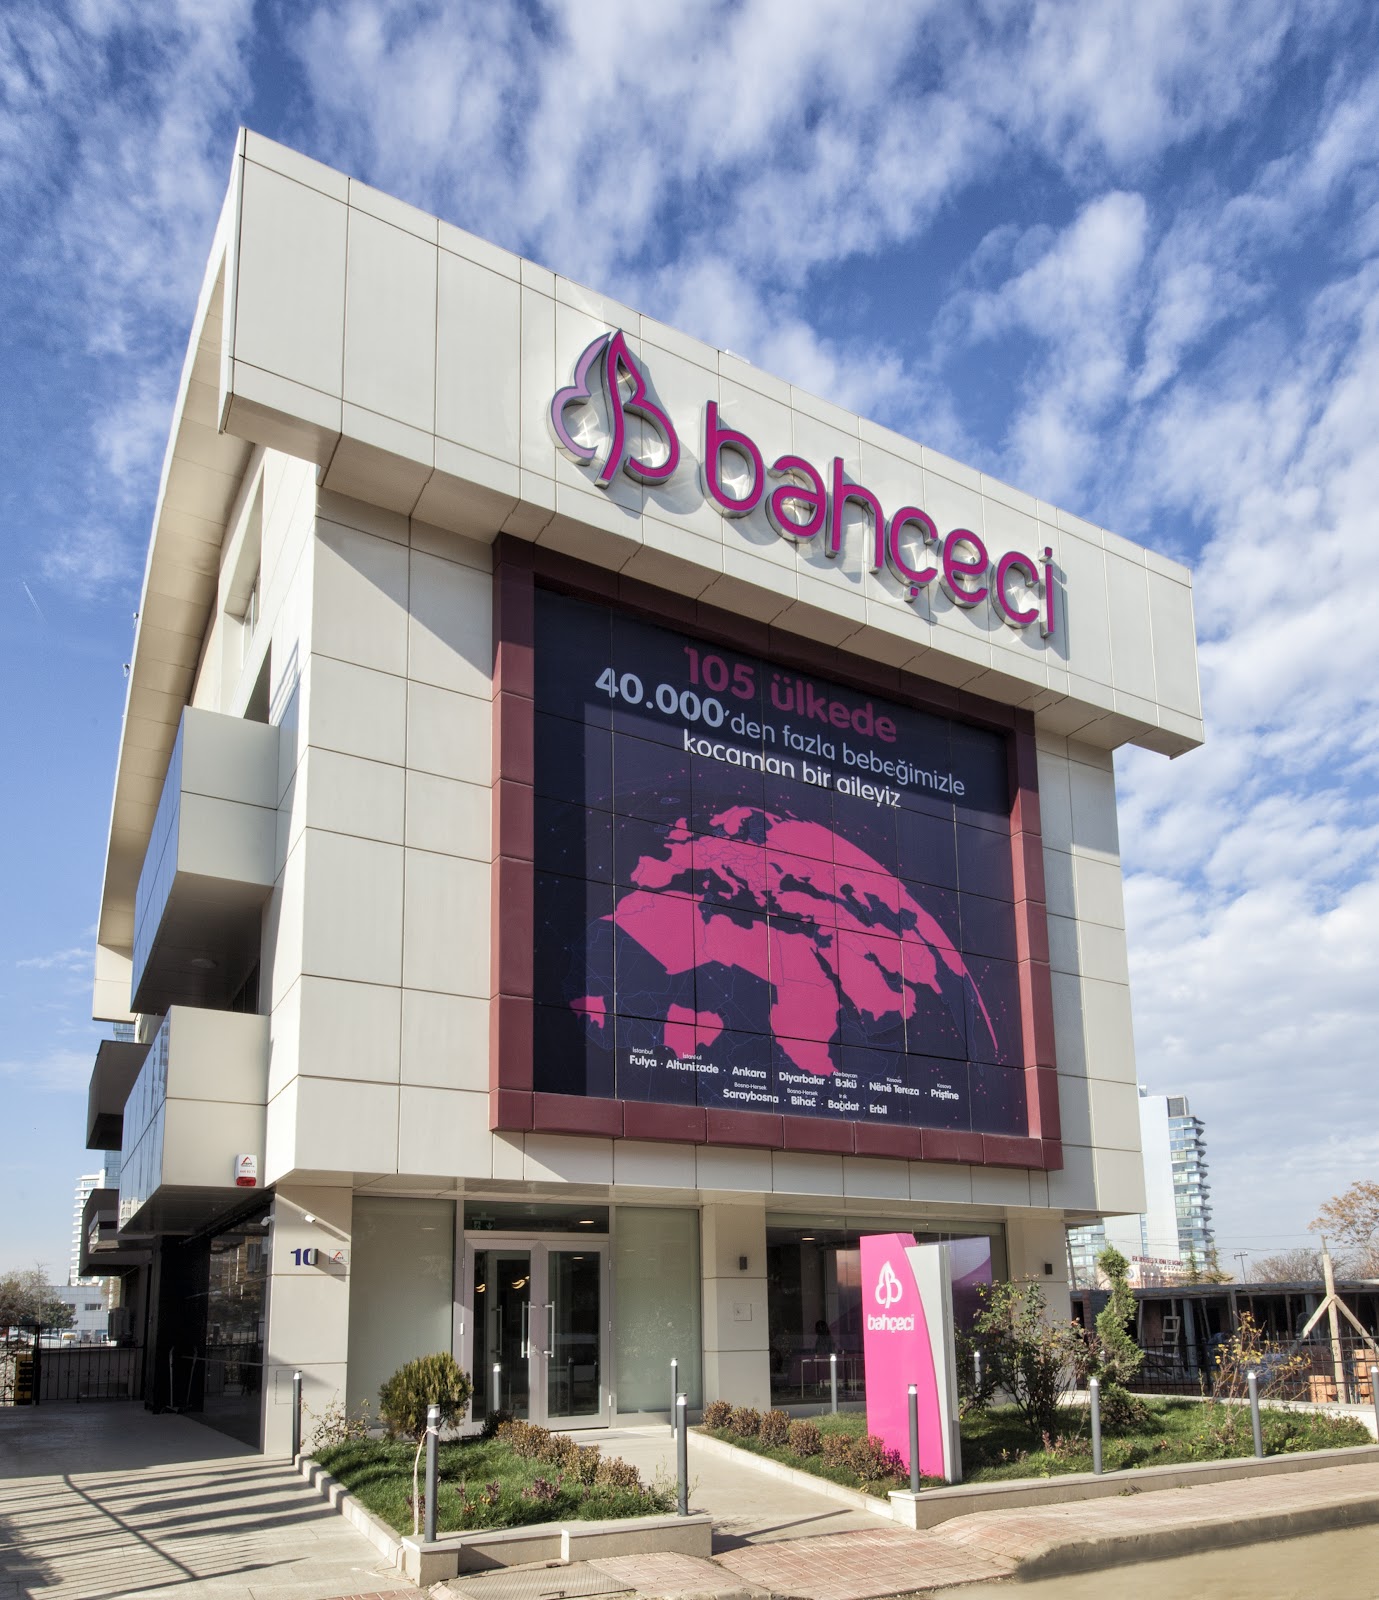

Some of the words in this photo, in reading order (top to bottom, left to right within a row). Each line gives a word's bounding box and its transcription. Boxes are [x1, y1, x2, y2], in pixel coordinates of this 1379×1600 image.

[702, 400, 1055, 638] bahçeci
[683, 646, 756, 700] 105
[770, 673, 897, 743] ülkede
[683, 728, 796, 779] kocaman
[802, 761, 831, 788] bir
[836, 776, 901, 807] aileyiz
[782, 724, 836, 761] fazla
[842, 742, 966, 796] bebeğimizle
[629, 1055, 657, 1069] Fulya
[666, 1059, 719, 1074] Altunizade
[732, 1066, 767, 1079] Ankara
[835, 1078, 857, 1089] Bakü
[869, 1082, 892, 1093] Nënë
[734, 1081, 767, 1091] Bosna-Hersek
[832, 1070, 858, 1079] Azebaycan
[723, 1088, 779, 1104] Saraybosna
[828, 1100, 860, 1112] Bağdat
[869, 1104, 888, 1115] Erbil
[867, 1313, 915, 1334] bahçeci
